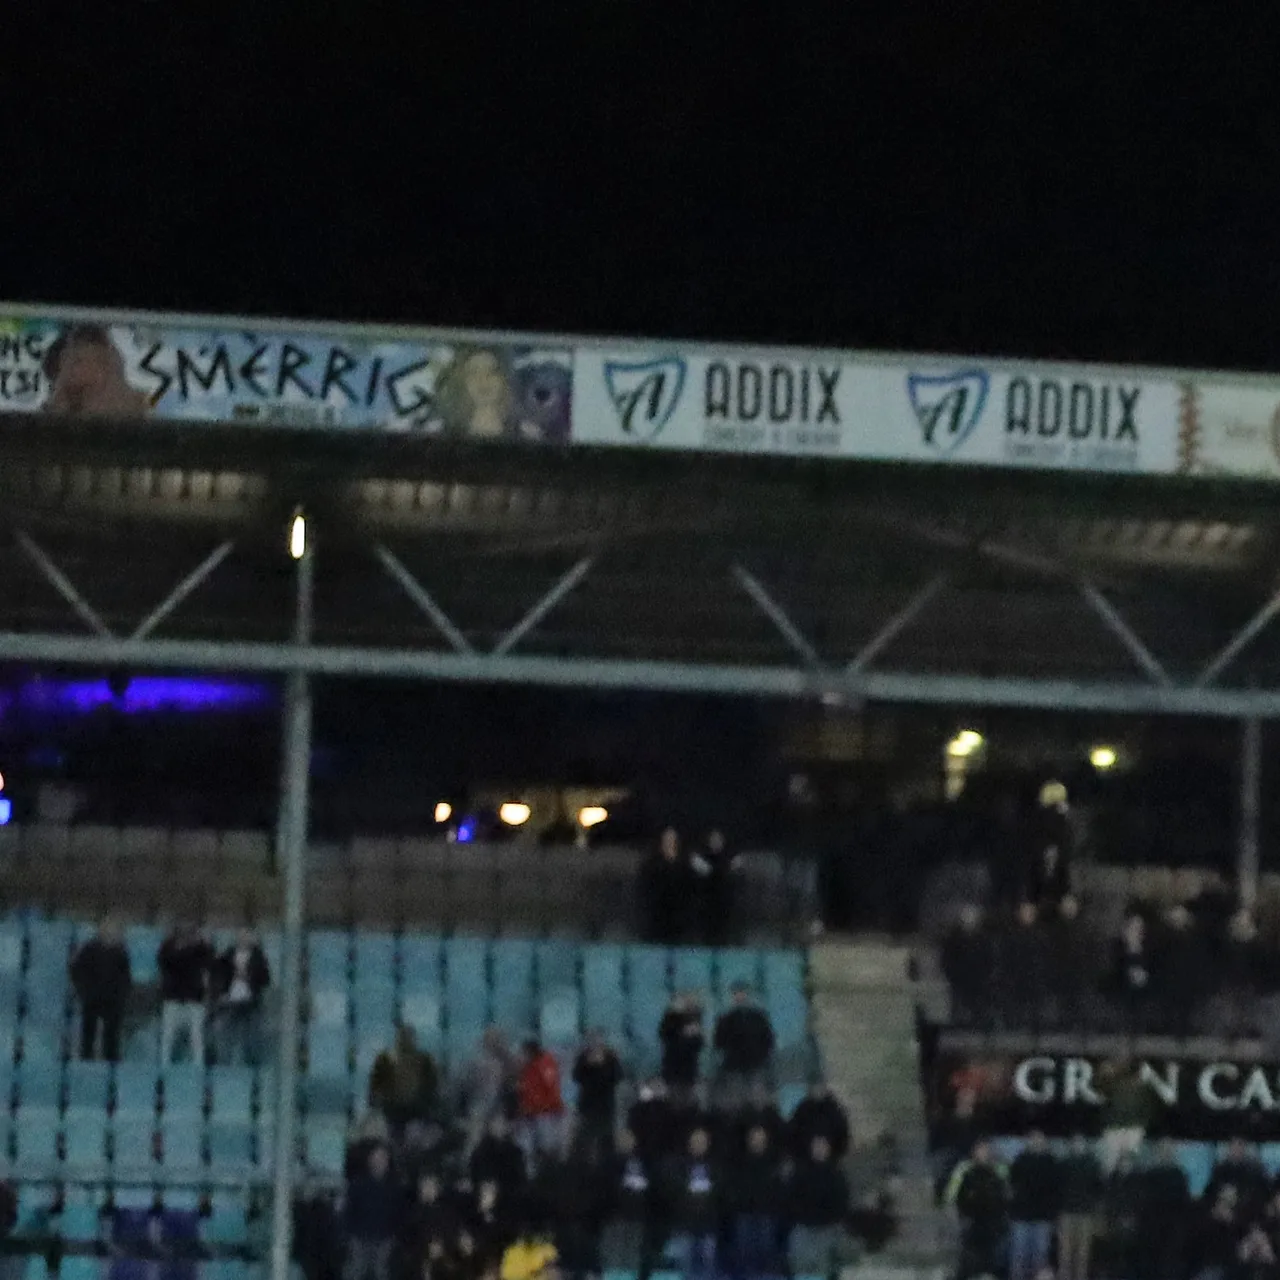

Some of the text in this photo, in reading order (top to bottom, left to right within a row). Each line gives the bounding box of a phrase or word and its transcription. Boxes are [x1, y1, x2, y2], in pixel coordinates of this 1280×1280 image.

[138, 338, 430, 420] SMERRIG
[704, 359, 841, 425] ADDIX
[1004, 375, 1141, 443] ADDIX
[1013, 1057, 1180, 1104] GRN
